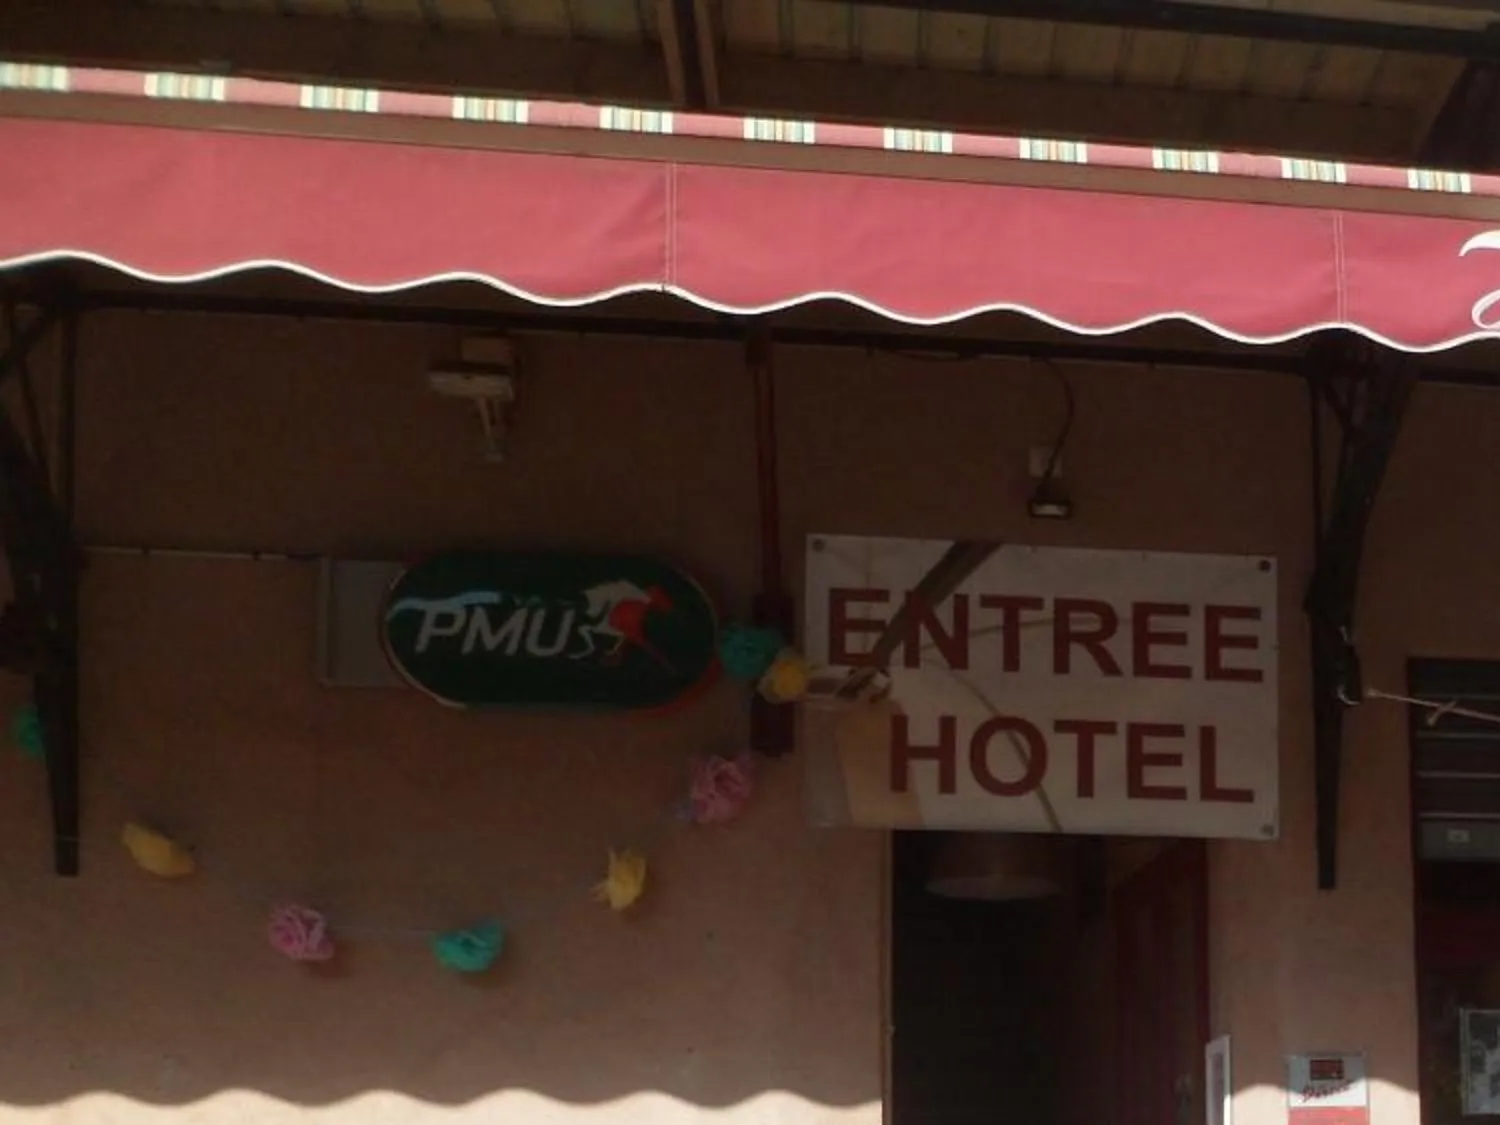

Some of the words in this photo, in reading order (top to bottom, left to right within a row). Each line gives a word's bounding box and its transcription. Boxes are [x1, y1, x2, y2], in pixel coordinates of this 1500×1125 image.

[402, 600, 578, 658] PMU
[827, 588, 1264, 682] ENTREE
[891, 717, 1254, 804] HOTEL
